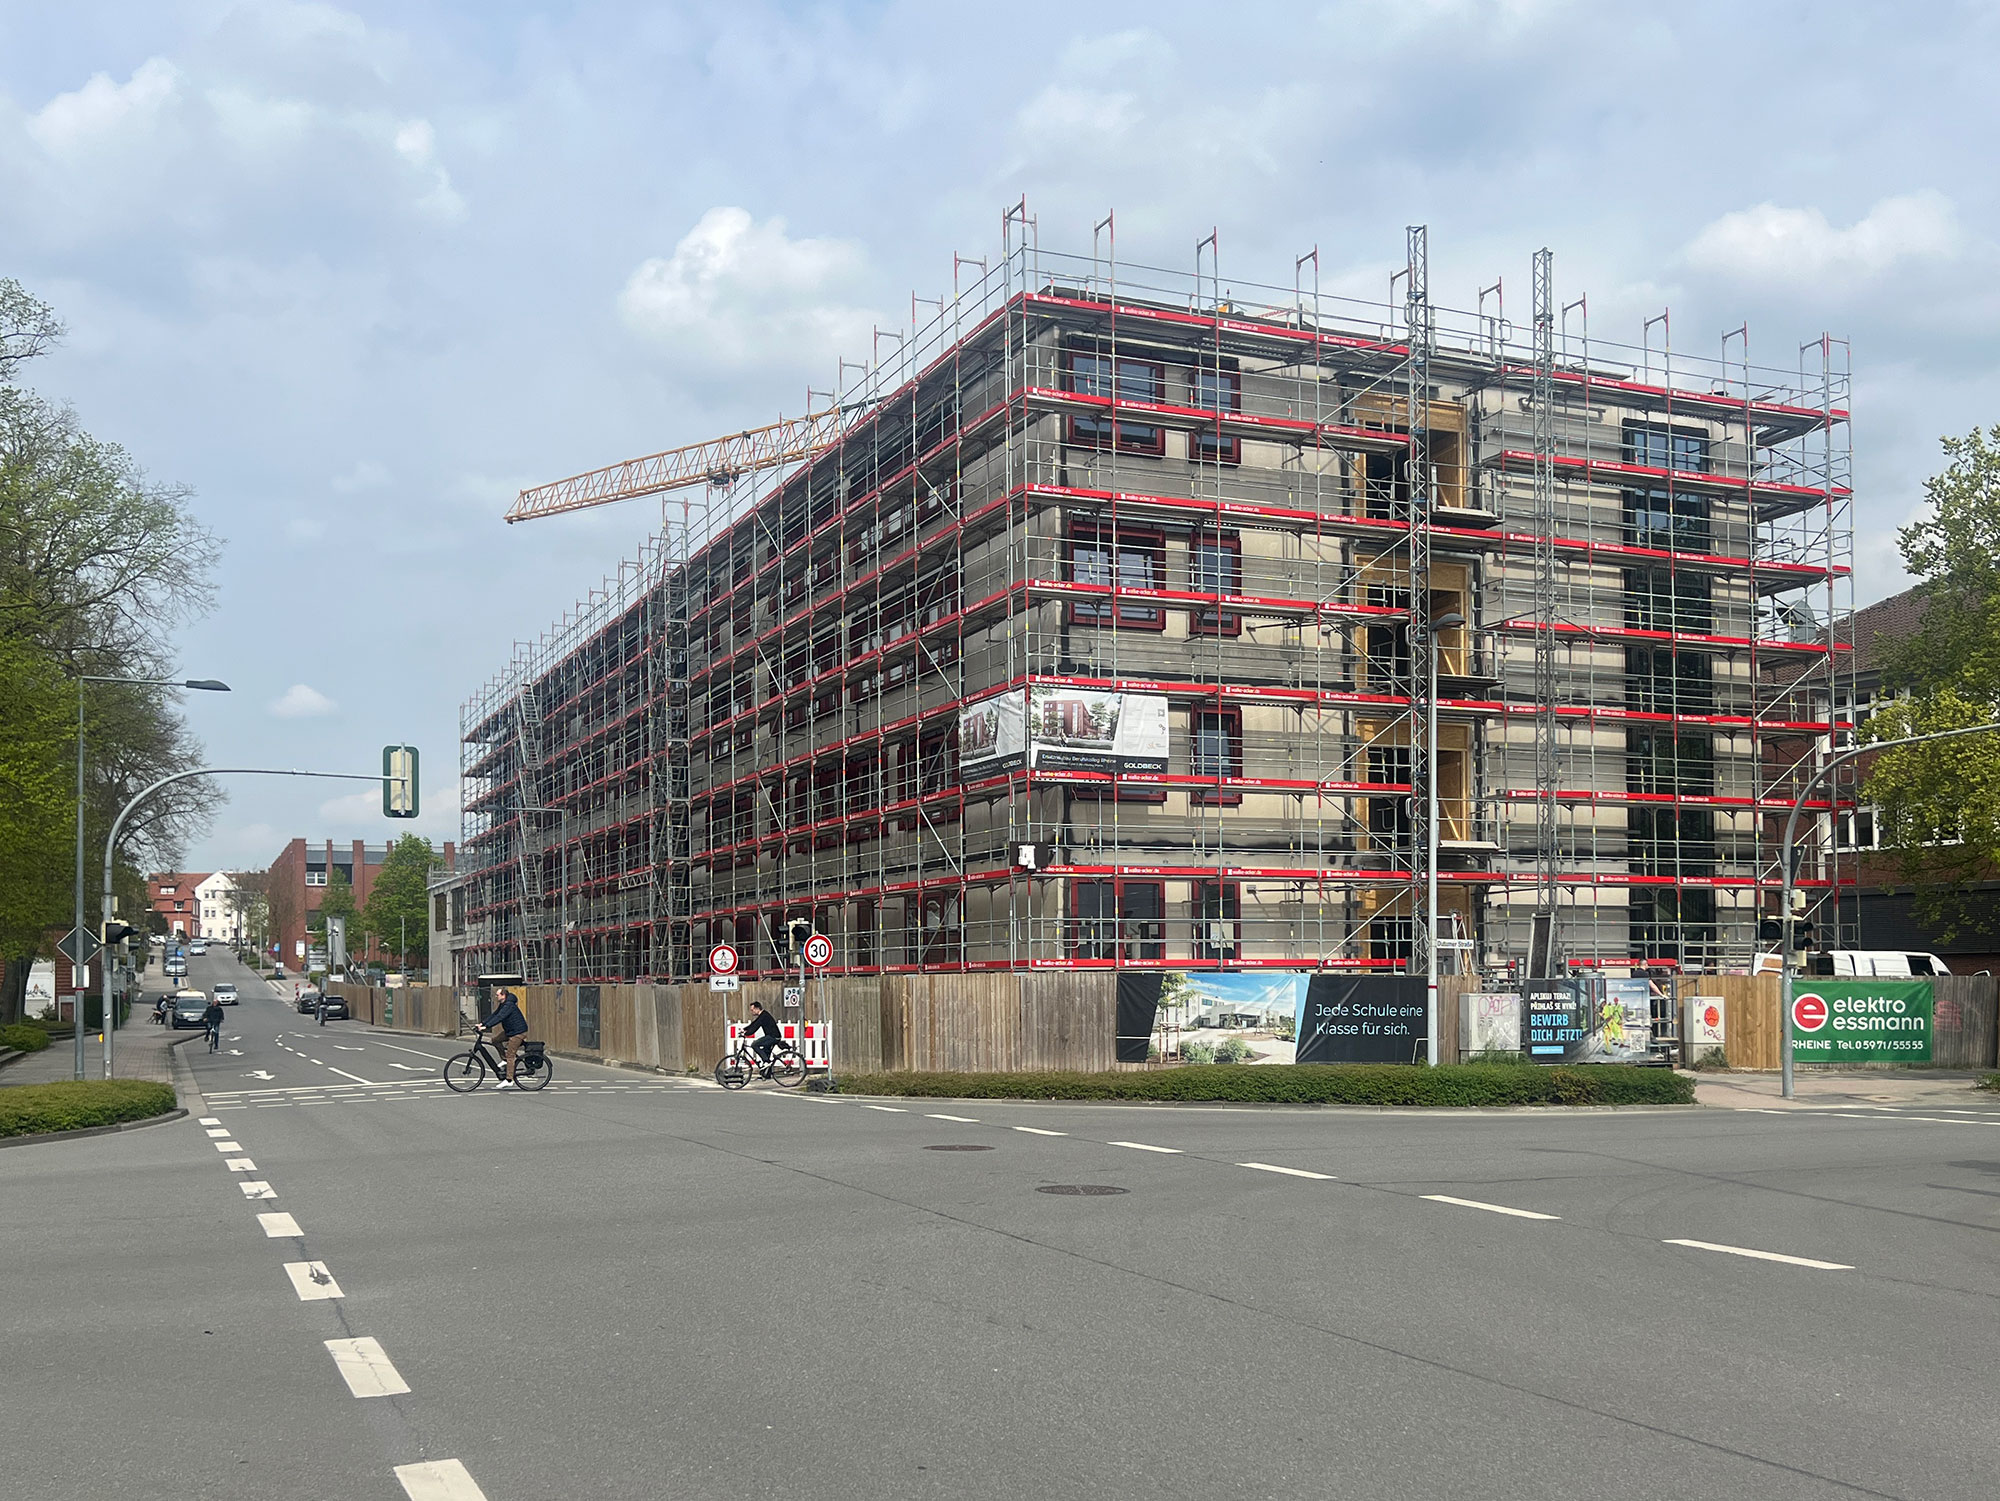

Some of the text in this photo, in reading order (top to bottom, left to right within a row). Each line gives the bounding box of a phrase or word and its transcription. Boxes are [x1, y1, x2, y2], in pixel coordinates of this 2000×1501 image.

[1124, 762, 1162, 770] GOLDBECK
[810, 943, 827, 958] 30
[1315, 1003, 1423, 1017] Jede Schule eine
[1554, 1002, 1561, 1010] SE
[1833, 996, 1906, 1014] elektro
[1530, 1014, 1569, 1027] BEWIRB
[1832, 1015, 1925, 1031] essmann
[1316, 1021, 1410, 1035] Klasse für sich.
[1531, 1029, 1553, 1041] DICH
[1556, 1028, 1583, 1041] JETZT!
[1792, 1040, 1831, 1049] RHEINE
